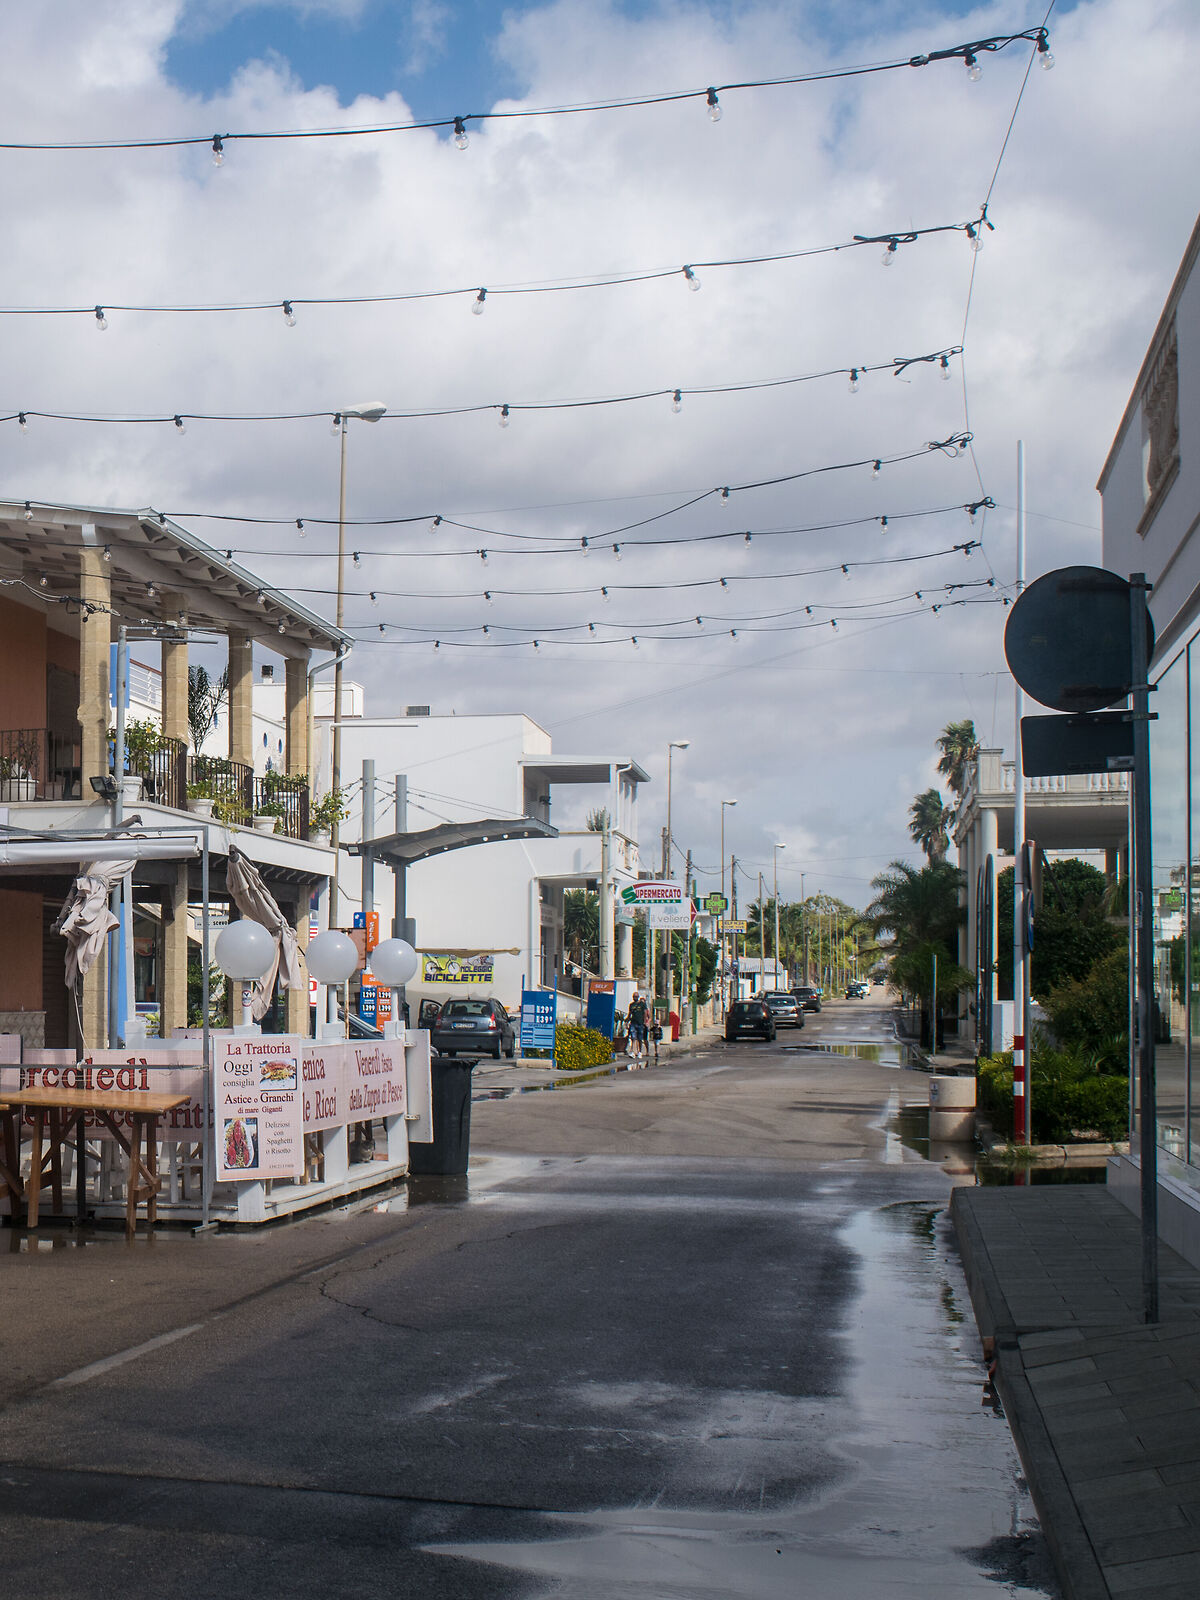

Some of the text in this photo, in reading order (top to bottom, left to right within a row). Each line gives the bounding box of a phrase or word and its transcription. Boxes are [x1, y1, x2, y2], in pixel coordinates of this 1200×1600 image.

[621, 886, 682, 905] SUPERMERCATO
[658, 914, 689, 922] veliero
[424, 973, 492, 981] BICICLETTE
[227, 1042, 291, 1056] La Trattoria
[223, 1060, 253, 1076] Oggi
[355, 1048, 381, 1077] Venerdì
[222, 1079, 255, 1088] consiglia
[224, 1093, 252, 1104] Astice
[260, 1092, 294, 1103] Granchi
[349, 1089, 363, 1111] della
[363, 1084, 381, 1113] Zuppa
[387, 1080, 403, 1103] Pesce
[261, 1105, 283, 1114] Giganti
[315, 1087, 337, 1120] Ricci
[266, 1137, 293, 1146] Spaghetti
